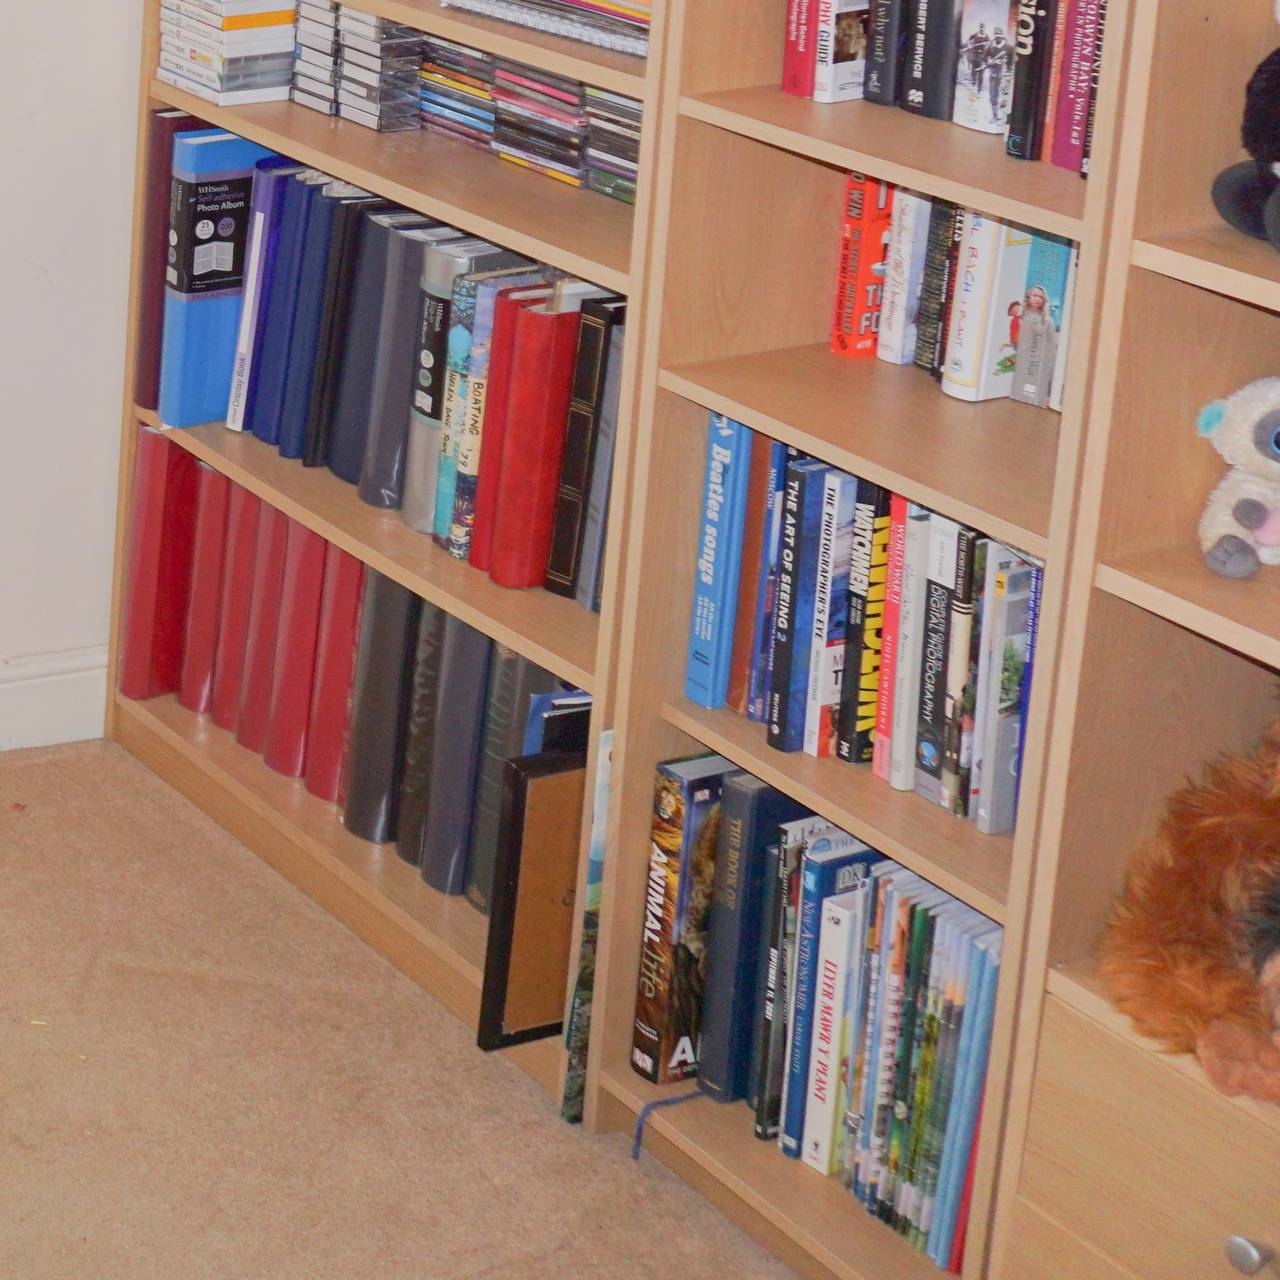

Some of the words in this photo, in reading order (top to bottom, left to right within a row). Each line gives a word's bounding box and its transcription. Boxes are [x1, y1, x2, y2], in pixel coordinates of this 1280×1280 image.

[874, 6, 889, 32] why
[1055, 2, 1066, 31] SHELF
[797, 25, 807, 52] Behind
[817, 30, 831, 67] GUIDE
[874, 34, 886, 62] not?
[912, 33, 926, 79] SERVICE
[1068, 27, 1084, 91] PHOTOGRAPHS
[197, 185, 229, 195] WHSmith
[197, 201, 220, 213] Photo
[220, 199, 246, 210] Album
[847, 188, 864, 220] WIN
[963, 246, 979, 293] BACH
[470, 381, 484, 436] BOATING
[706, 443, 732, 522] Beatles
[766, 466, 777, 511] MOSCOW
[785, 479, 800, 512] THE
[826, 485, 836, 508] THE
[783, 512, 796, 546] ART
[894, 523, 905, 566] WORLD
[699, 524, 717, 586] songs
[781, 548, 794, 572] OF
[816, 511, 834, 615] PHOTOGRAPHER'S
[848, 502, 875, 597] WATCHMEN
[891, 592, 901, 604] II
[892, 568, 903, 592] WAR
[777, 572, 792, 629] SEEING
[928, 584, 941, 629] DIGITAL
[937, 588, 948, 631] COMPLETE
[777, 631, 787, 642] 2
[814, 618, 824, 640] EYE
[883, 633, 892, 664] NIGEL
[936, 633, 946, 658] GUIDE
[922, 631, 939, 723] PHOTOGRAPHY
[771, 692, 780, 722] REUTERS
[879, 668, 890, 730] CAWTHORNE
[728, 817, 742, 848] THE
[726, 848, 740, 889] BOOK
[643, 841, 669, 944] ANIMAL
[724, 888, 737, 910] OF
[639, 946, 666, 999] life
[796, 927, 814, 1011] ASTRONOMER
[822, 959, 838, 1000] LLYFR
[819, 1001, 834, 1045] MAWR
[819, 1047, 830, 1057] Y
[814, 1060, 828, 1104] PLANT
